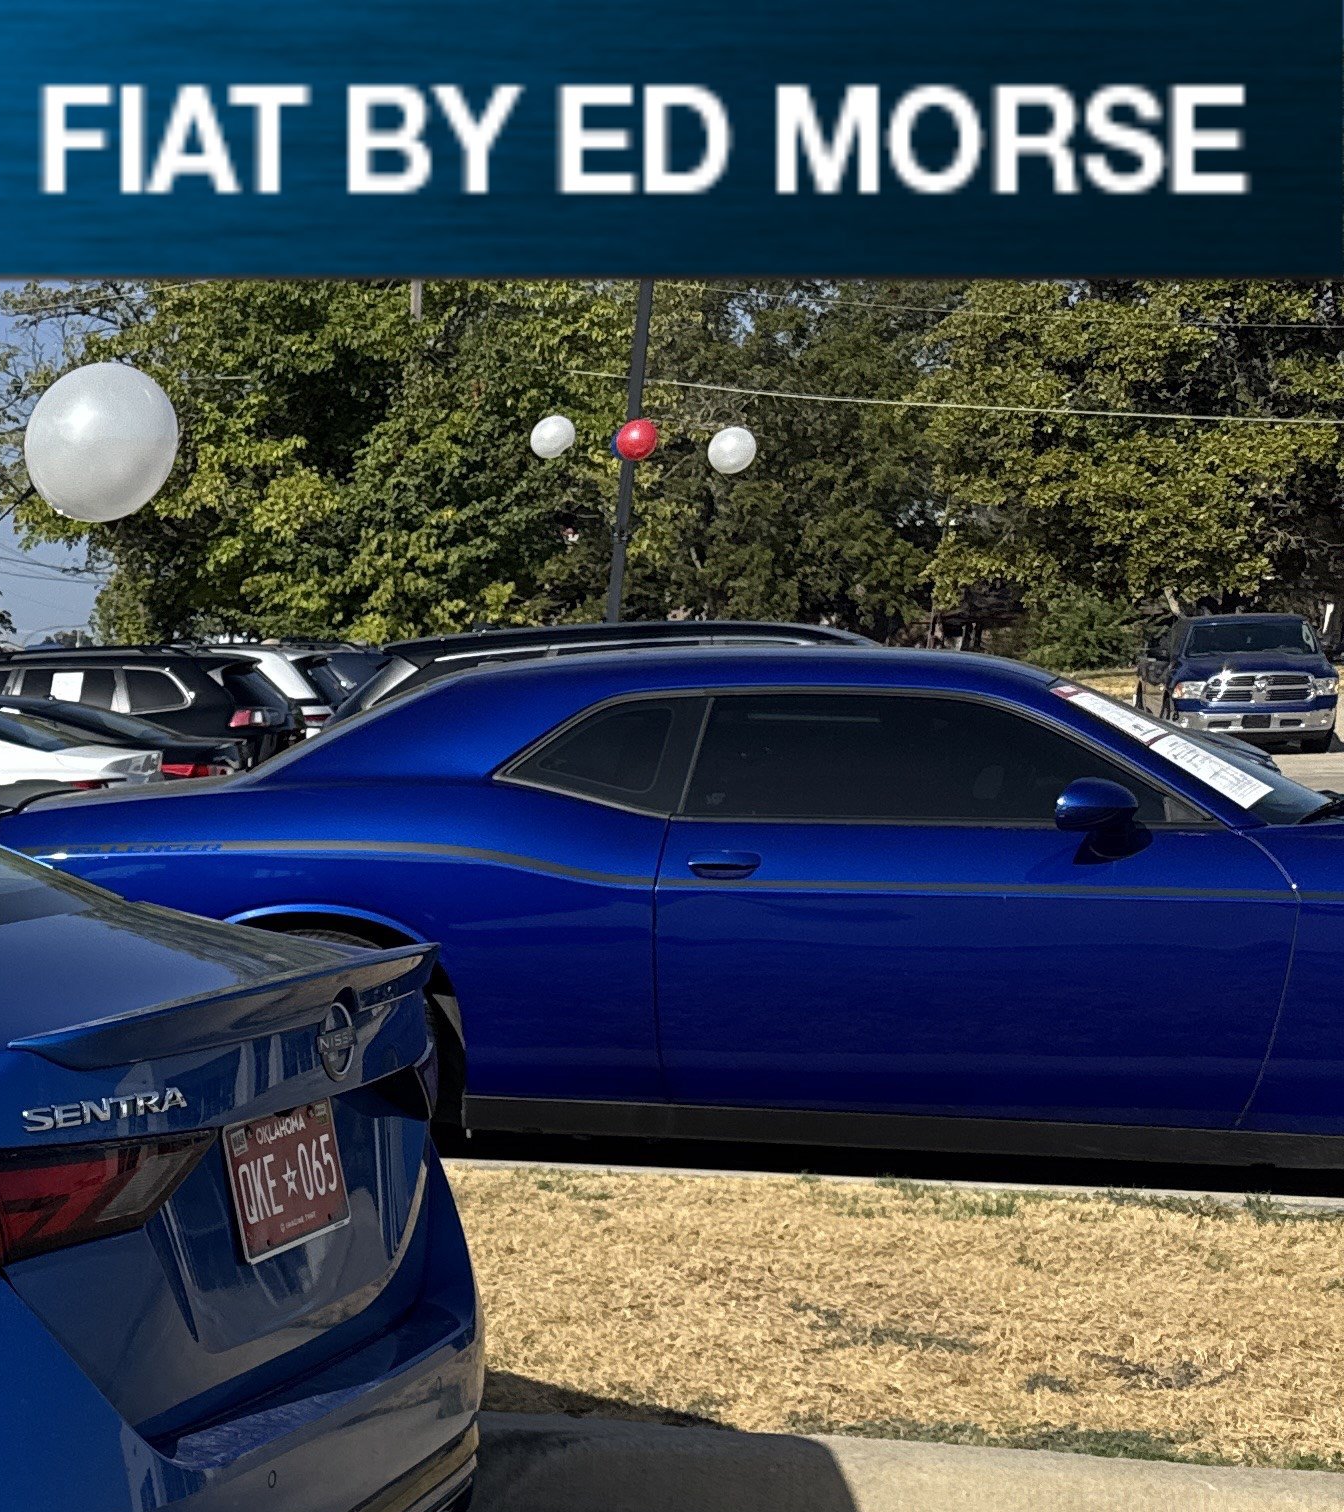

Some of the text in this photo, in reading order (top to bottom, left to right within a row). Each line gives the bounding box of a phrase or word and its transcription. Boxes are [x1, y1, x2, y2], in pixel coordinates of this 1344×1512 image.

[319, 1031, 354, 1052] NISS
[22, 1087, 187, 1132] SENTRA
[255, 1113, 307, 1145] OKLAHOMA
[238, 1153, 284, 1225] QKE
[298, 1133, 339, 1201] 065
